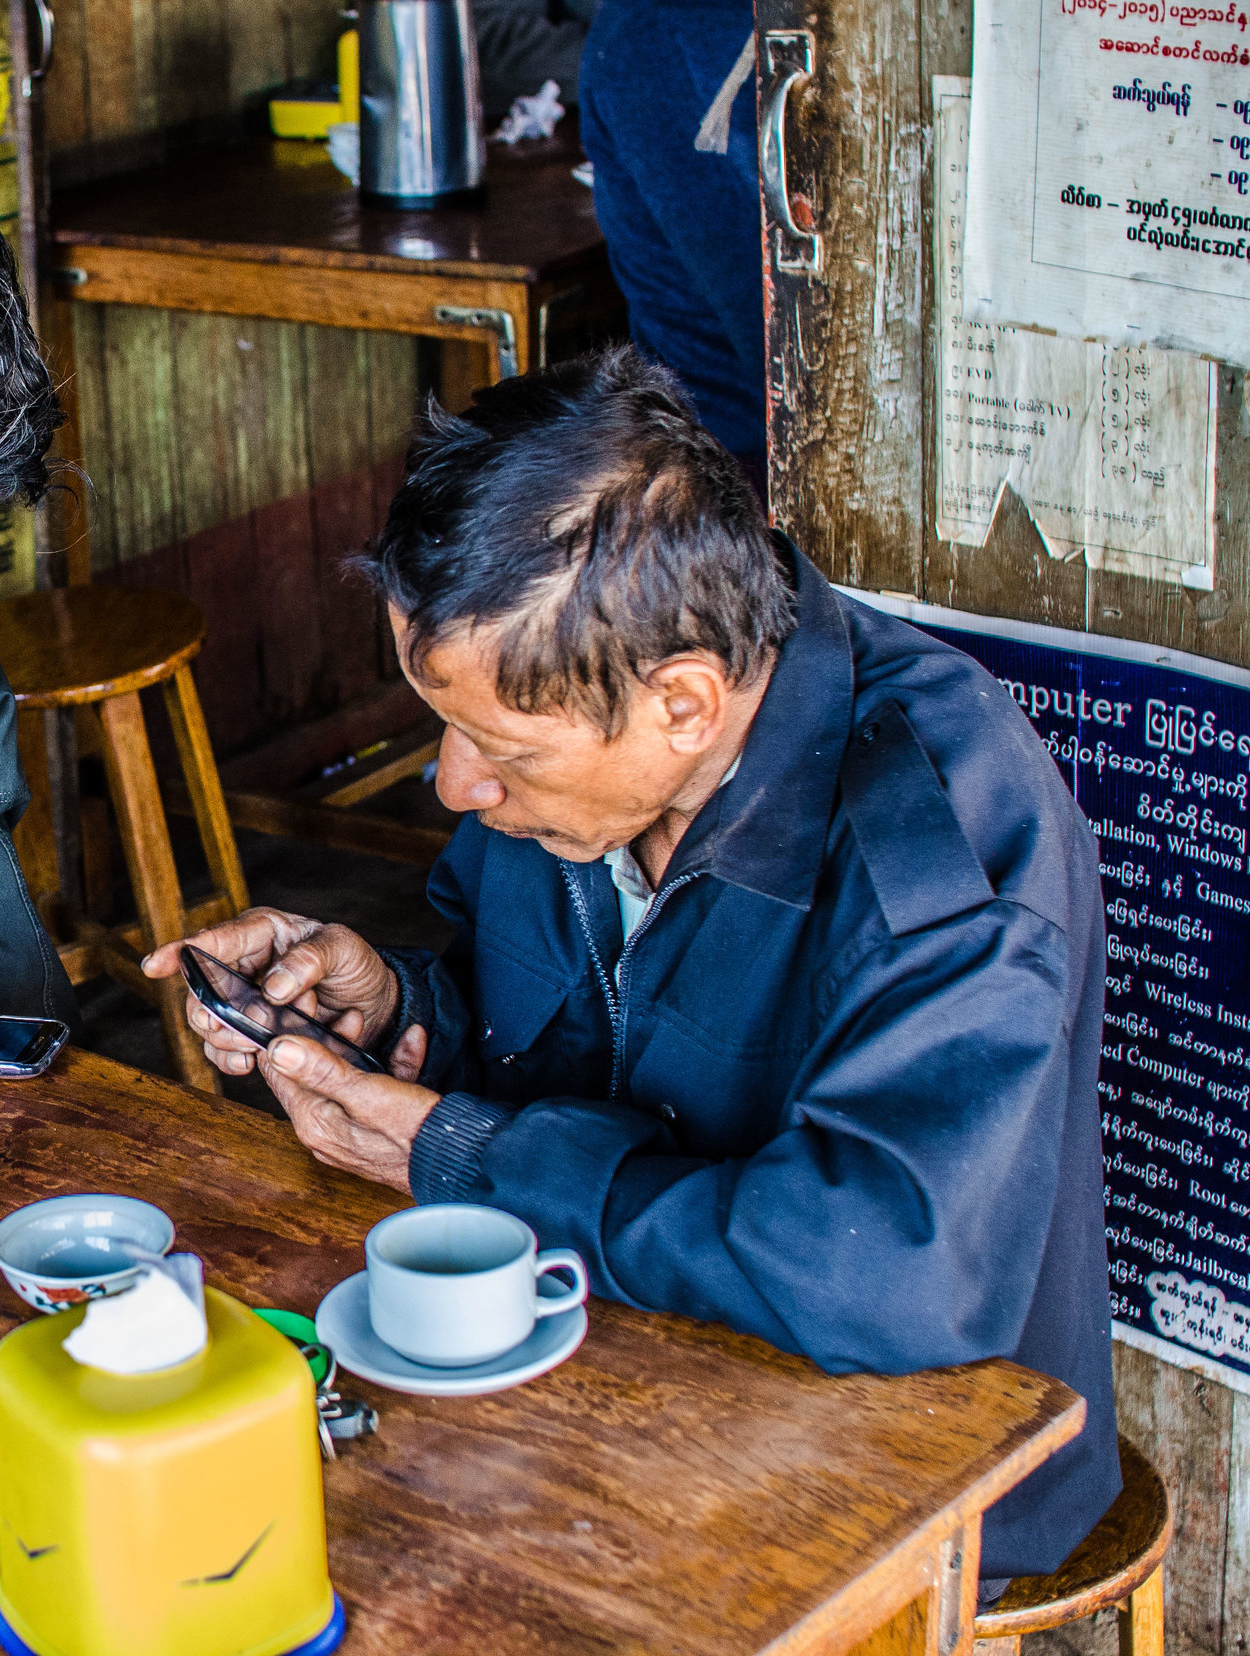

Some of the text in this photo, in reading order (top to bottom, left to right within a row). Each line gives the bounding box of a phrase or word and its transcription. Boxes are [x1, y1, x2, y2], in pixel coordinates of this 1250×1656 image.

[1166, 833, 1243, 872] Windows
[1144, 980, 1212, 1019] Wireless
[1126, 1045, 1205, 1089] Computer
[1188, 1178, 1227, 1208] Root
